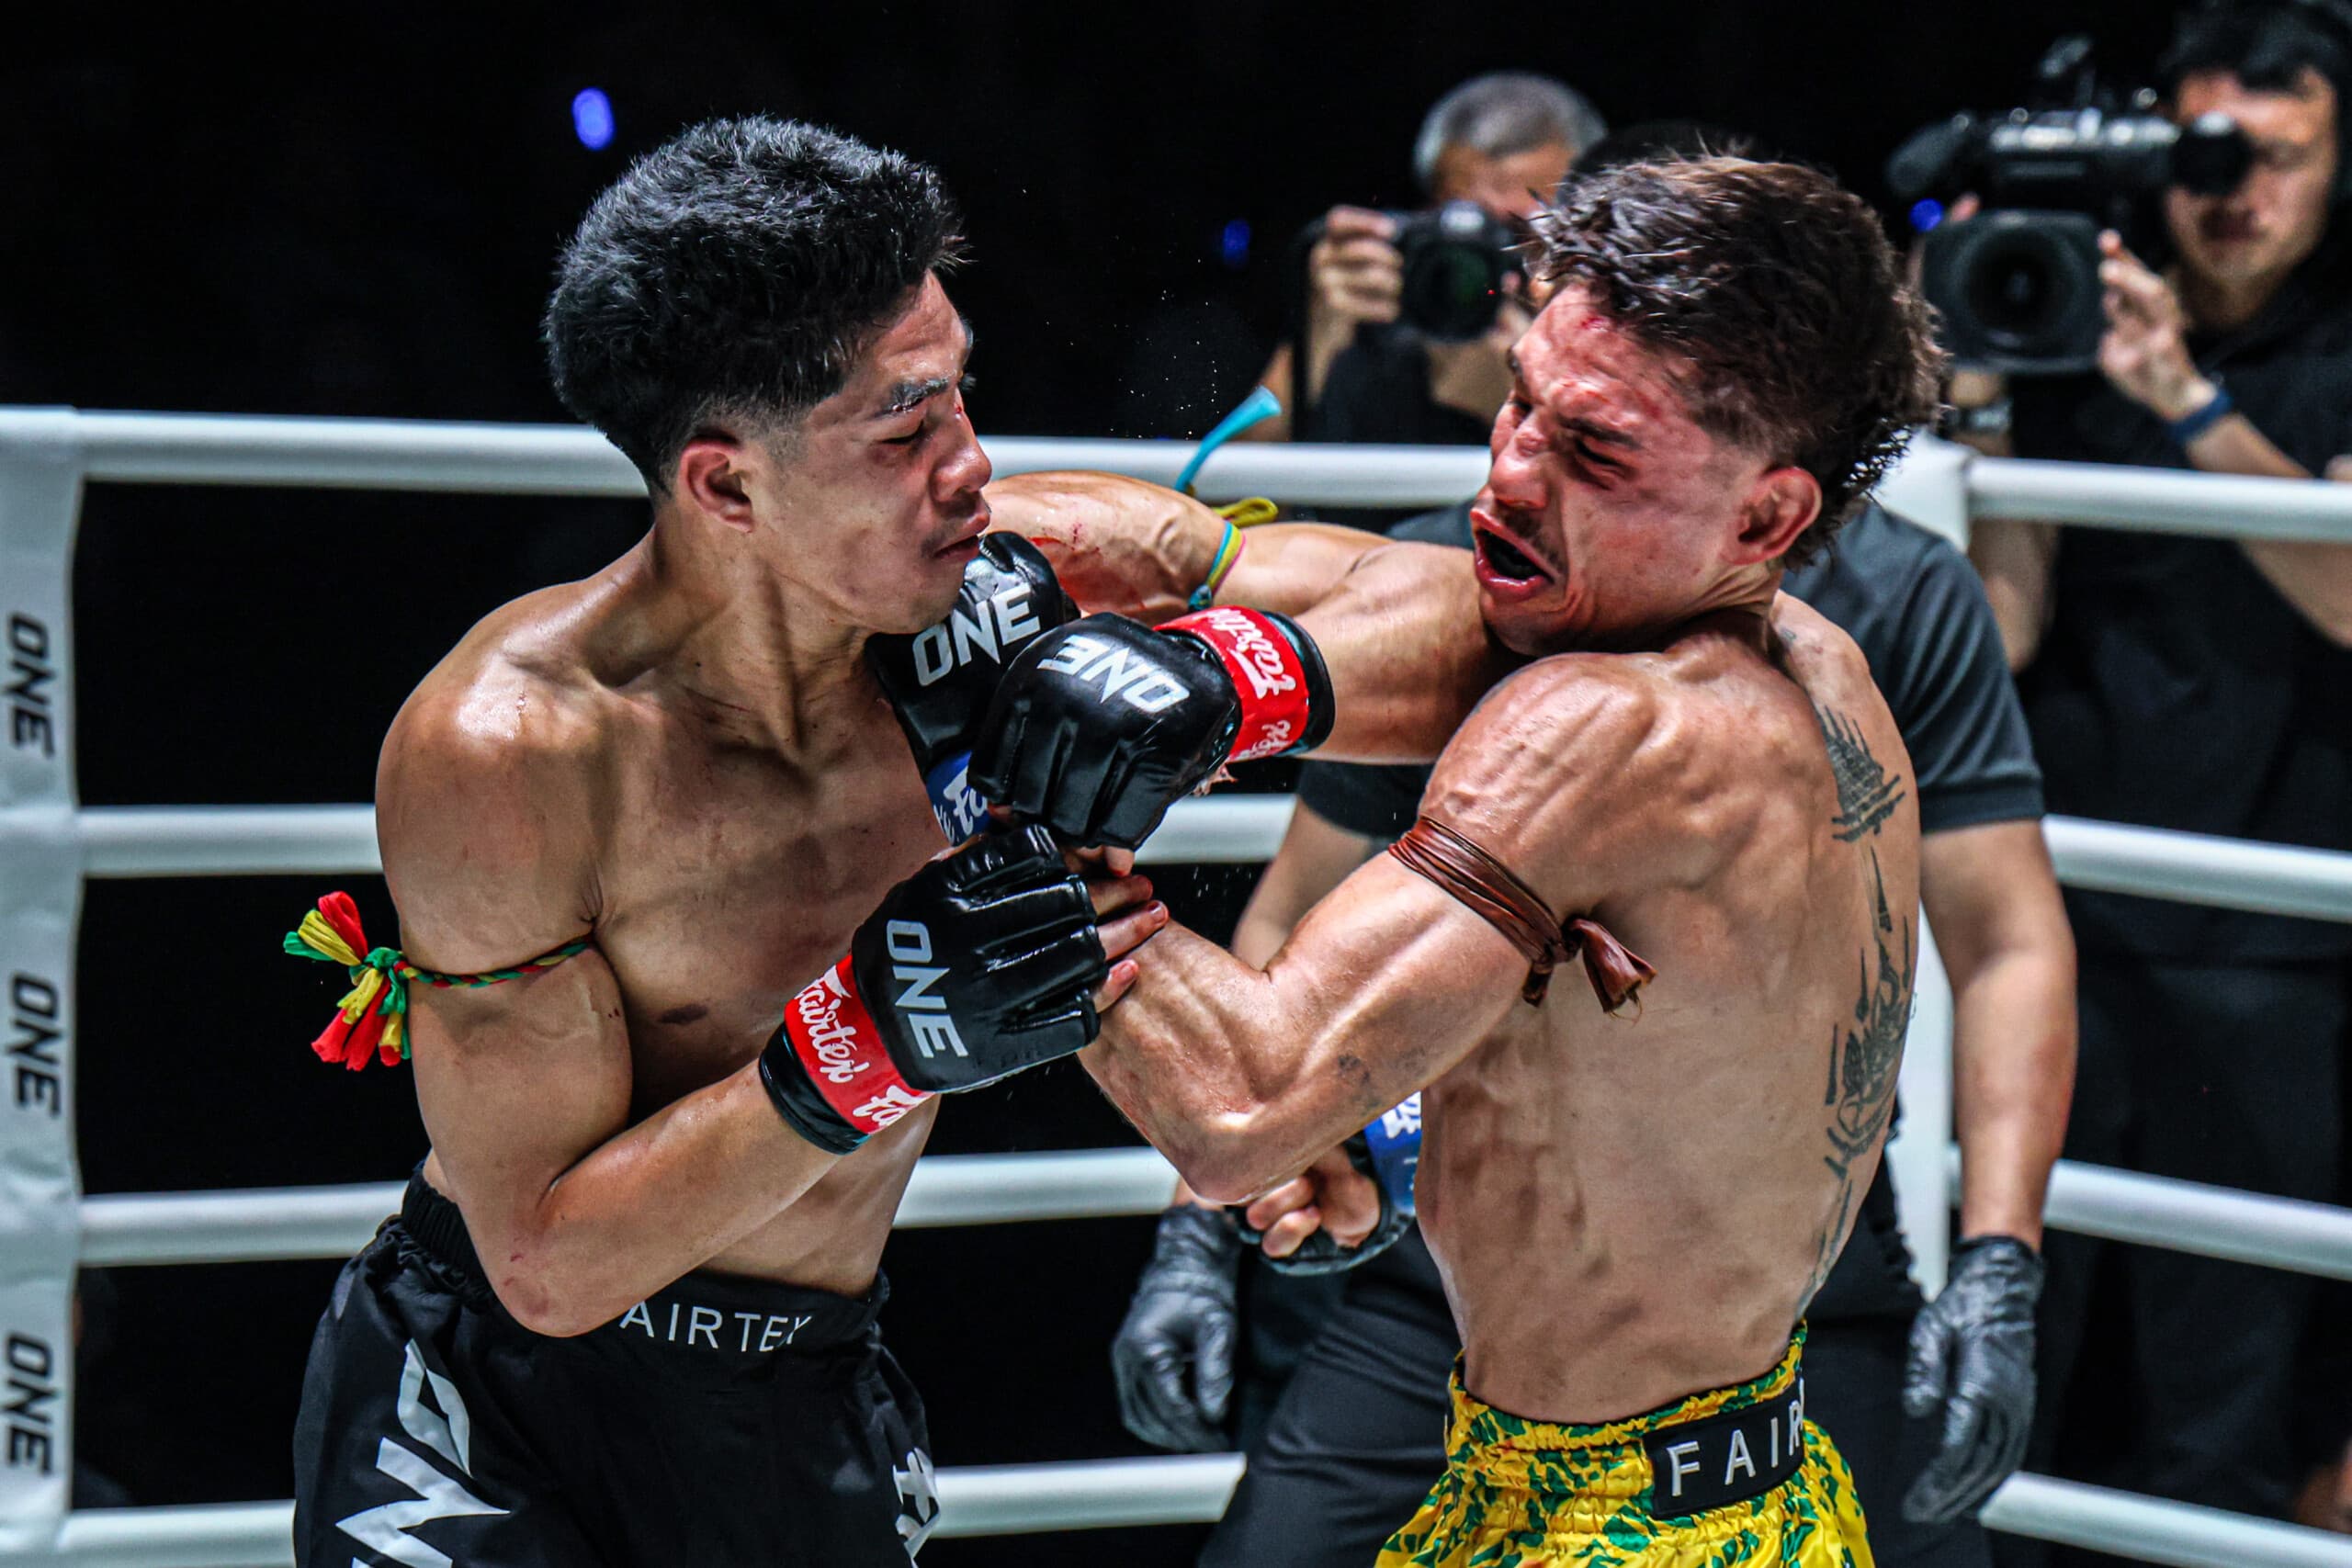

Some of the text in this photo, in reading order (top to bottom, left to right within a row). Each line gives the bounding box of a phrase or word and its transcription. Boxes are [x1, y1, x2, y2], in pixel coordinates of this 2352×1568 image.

[3, 612, 57, 759] ONE
[912, 582, 1041, 686] ONE
[1036, 634, 1191, 714] ONE
[6, 971, 62, 1119] ONE
[887, 919, 969, 1058] ONE
[619, 1300, 813, 1353] AIRTEX
[3, 1334, 58, 1478] ONE
[334, 1337, 512, 1568] ON
[1666, 1378, 1804, 1497] FAIR
